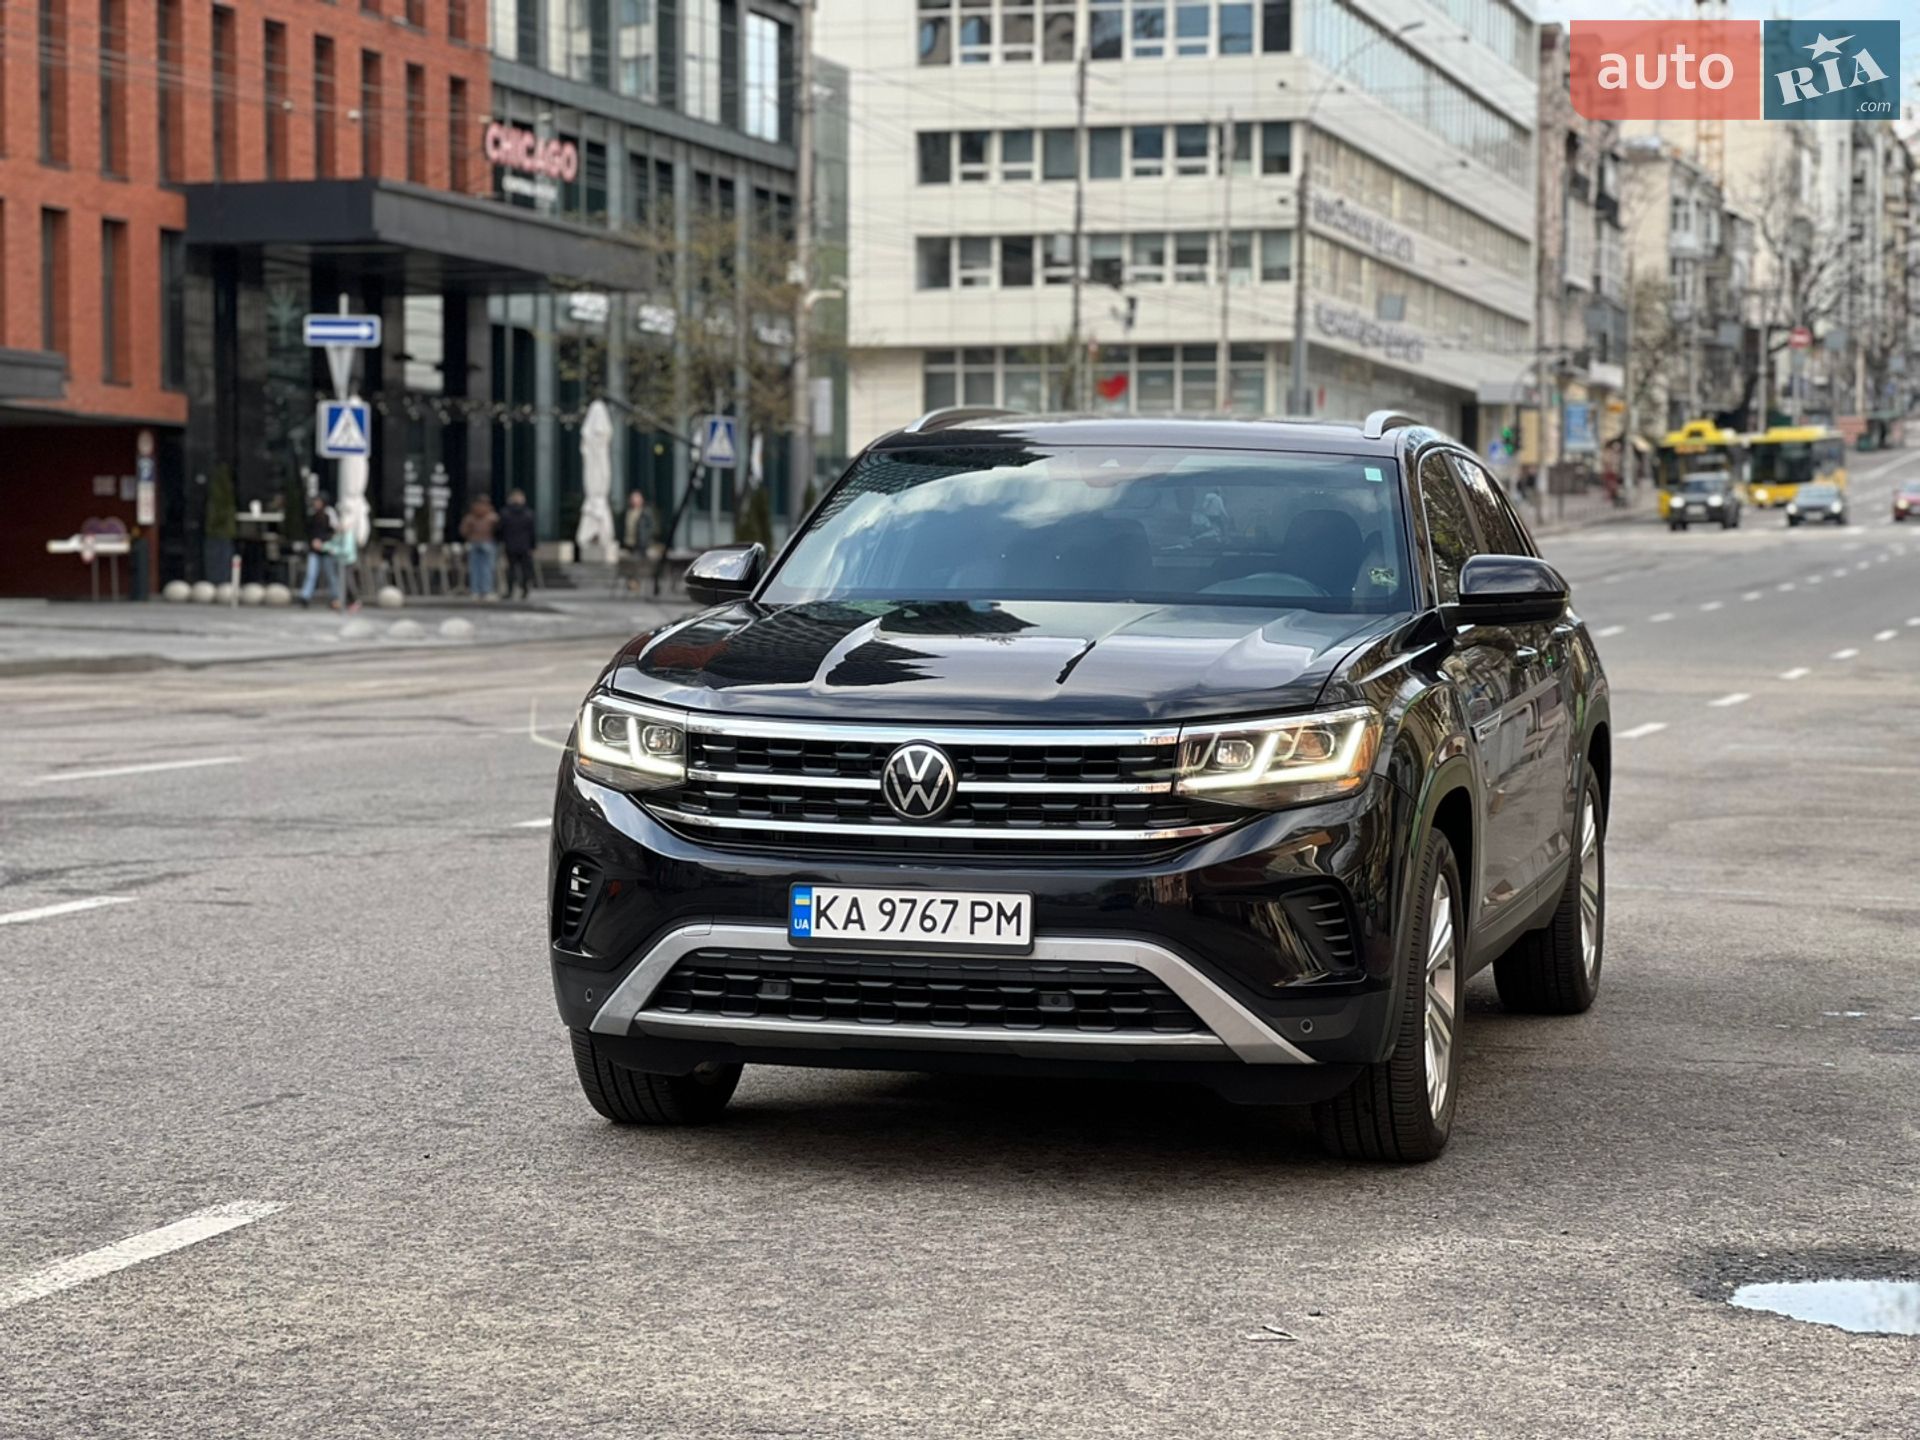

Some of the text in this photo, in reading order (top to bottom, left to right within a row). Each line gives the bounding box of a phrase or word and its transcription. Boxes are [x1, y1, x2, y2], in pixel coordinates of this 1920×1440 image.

[485, 122, 578, 183] CHICAGO
[794, 918, 809, 930] UA
[814, 895, 1022, 936] KA 9767 PM
